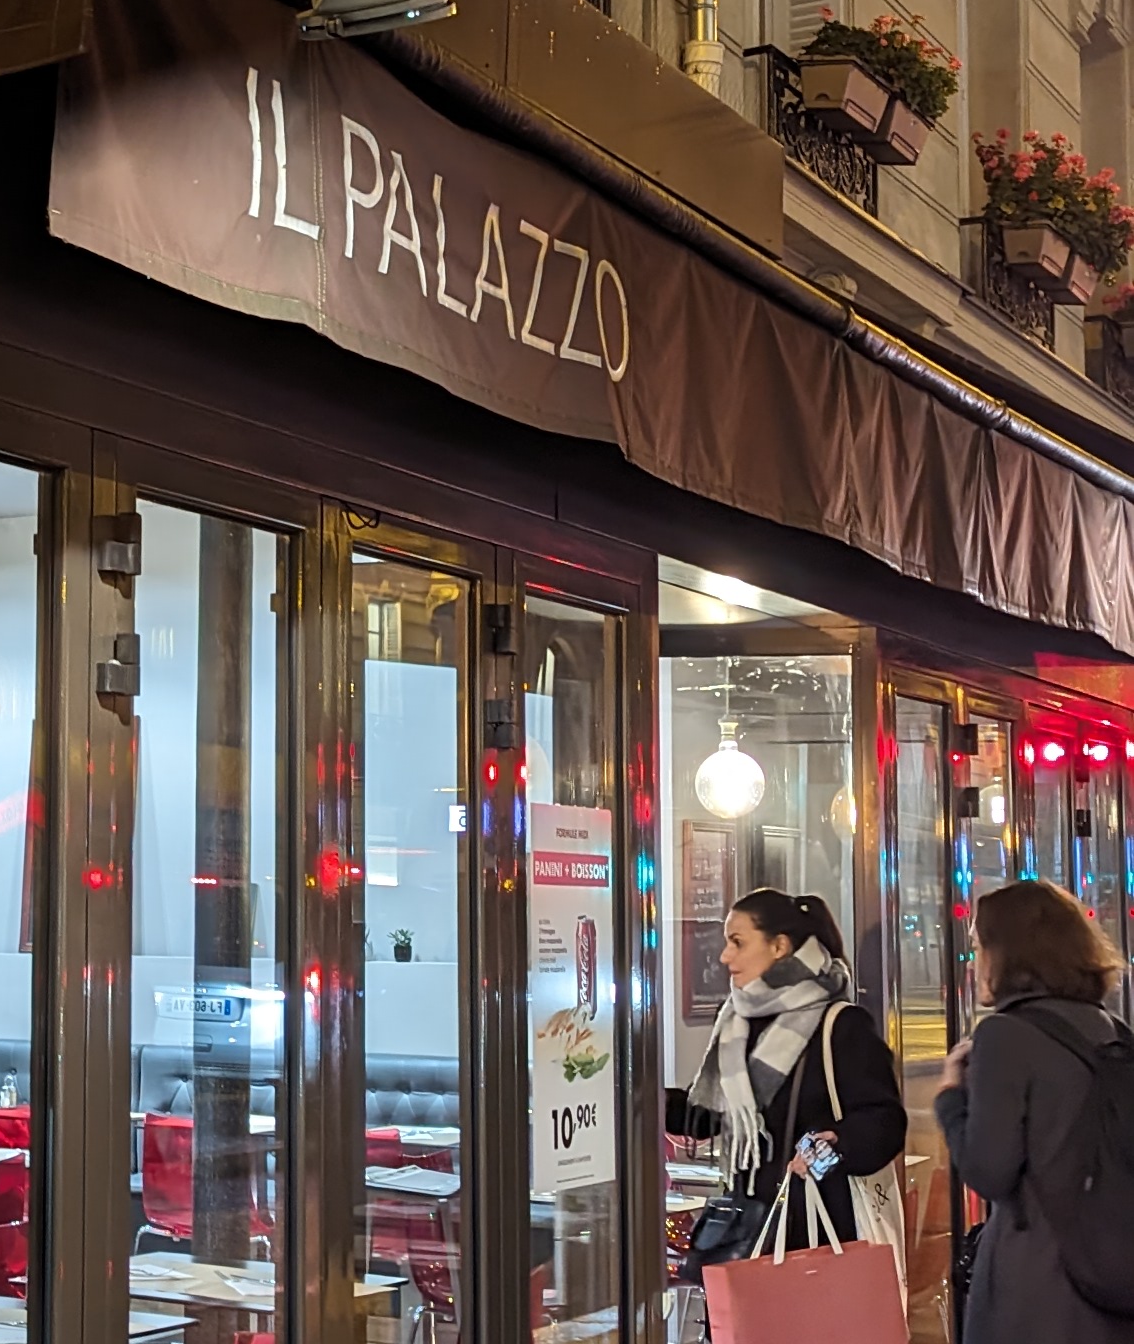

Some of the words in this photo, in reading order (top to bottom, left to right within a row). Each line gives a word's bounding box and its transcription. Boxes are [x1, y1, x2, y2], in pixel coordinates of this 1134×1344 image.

[246, 66, 320, 241] IL
[341, 114, 630, 383] PALAZZO
[534, 860, 563, 877] PANINI
